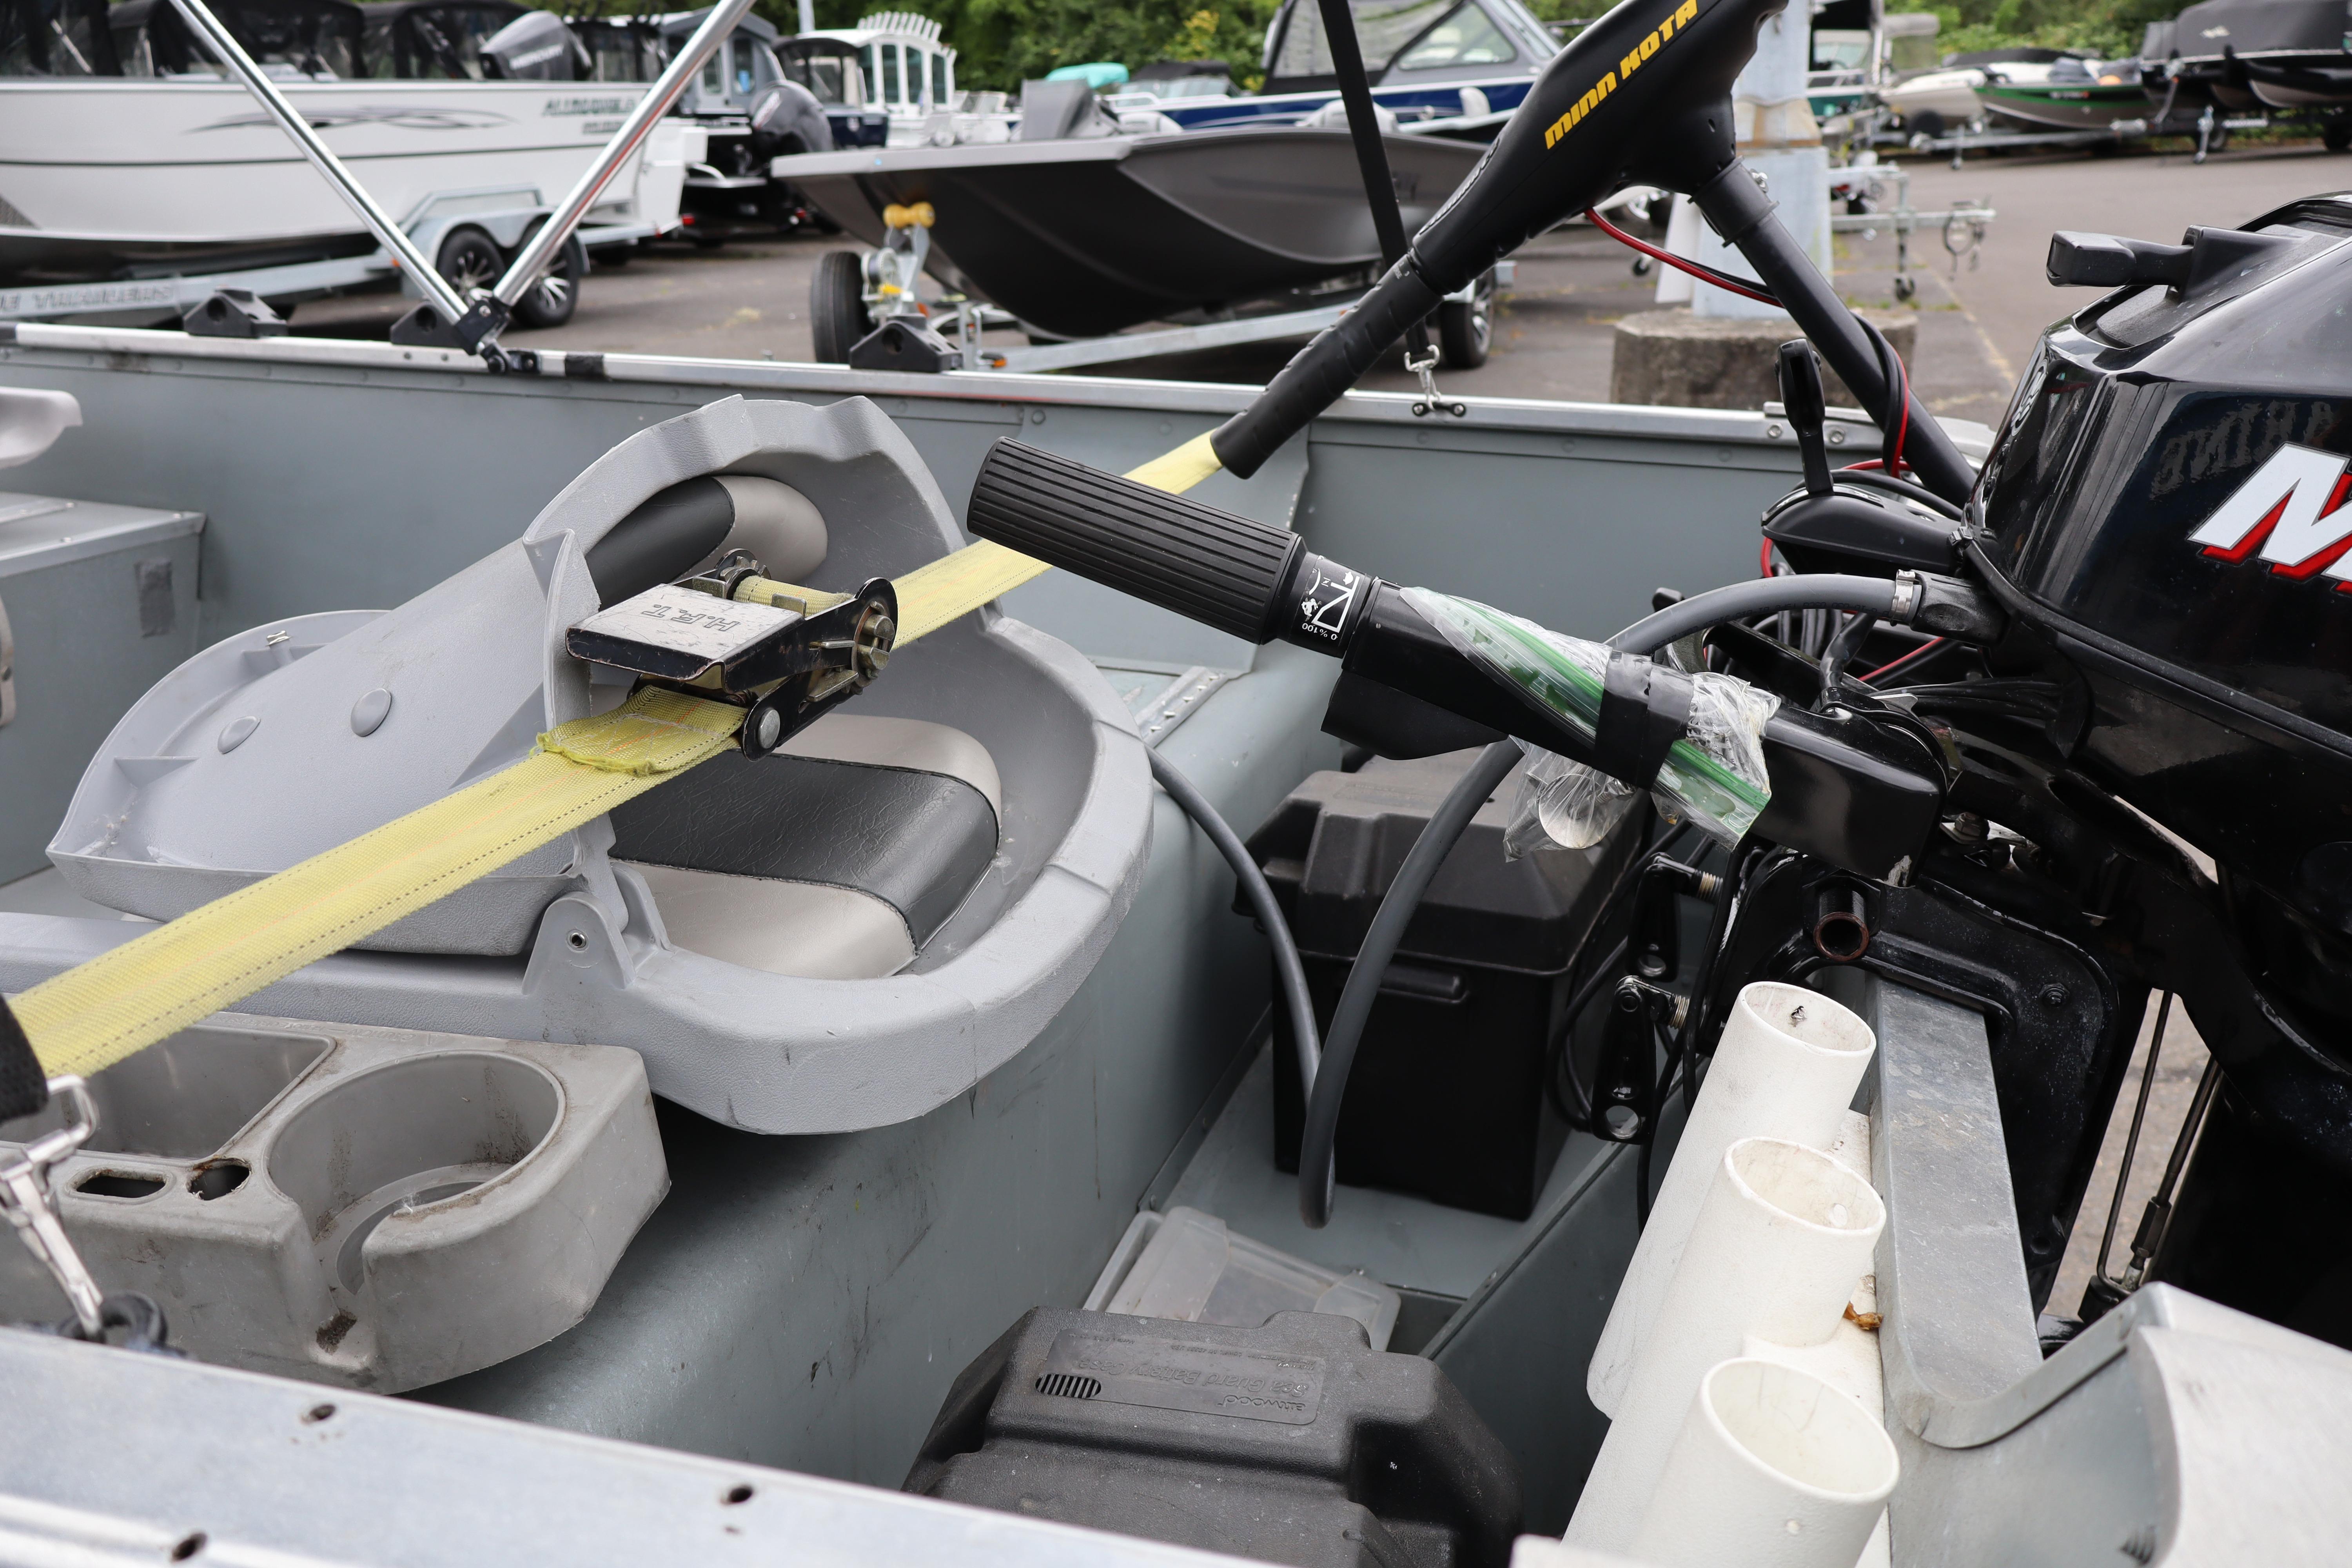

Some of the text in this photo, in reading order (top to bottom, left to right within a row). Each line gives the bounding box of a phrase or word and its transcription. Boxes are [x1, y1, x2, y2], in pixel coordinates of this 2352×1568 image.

[1620, 0, 1698, 80] KOTA
[1302, 623, 1318, 633] 100
[1319, 629, 1328, 637] %
[1078, 1359, 1308, 1397] Sea Guard Battery Case
[1217, 1395, 1306, 1412] attwood
